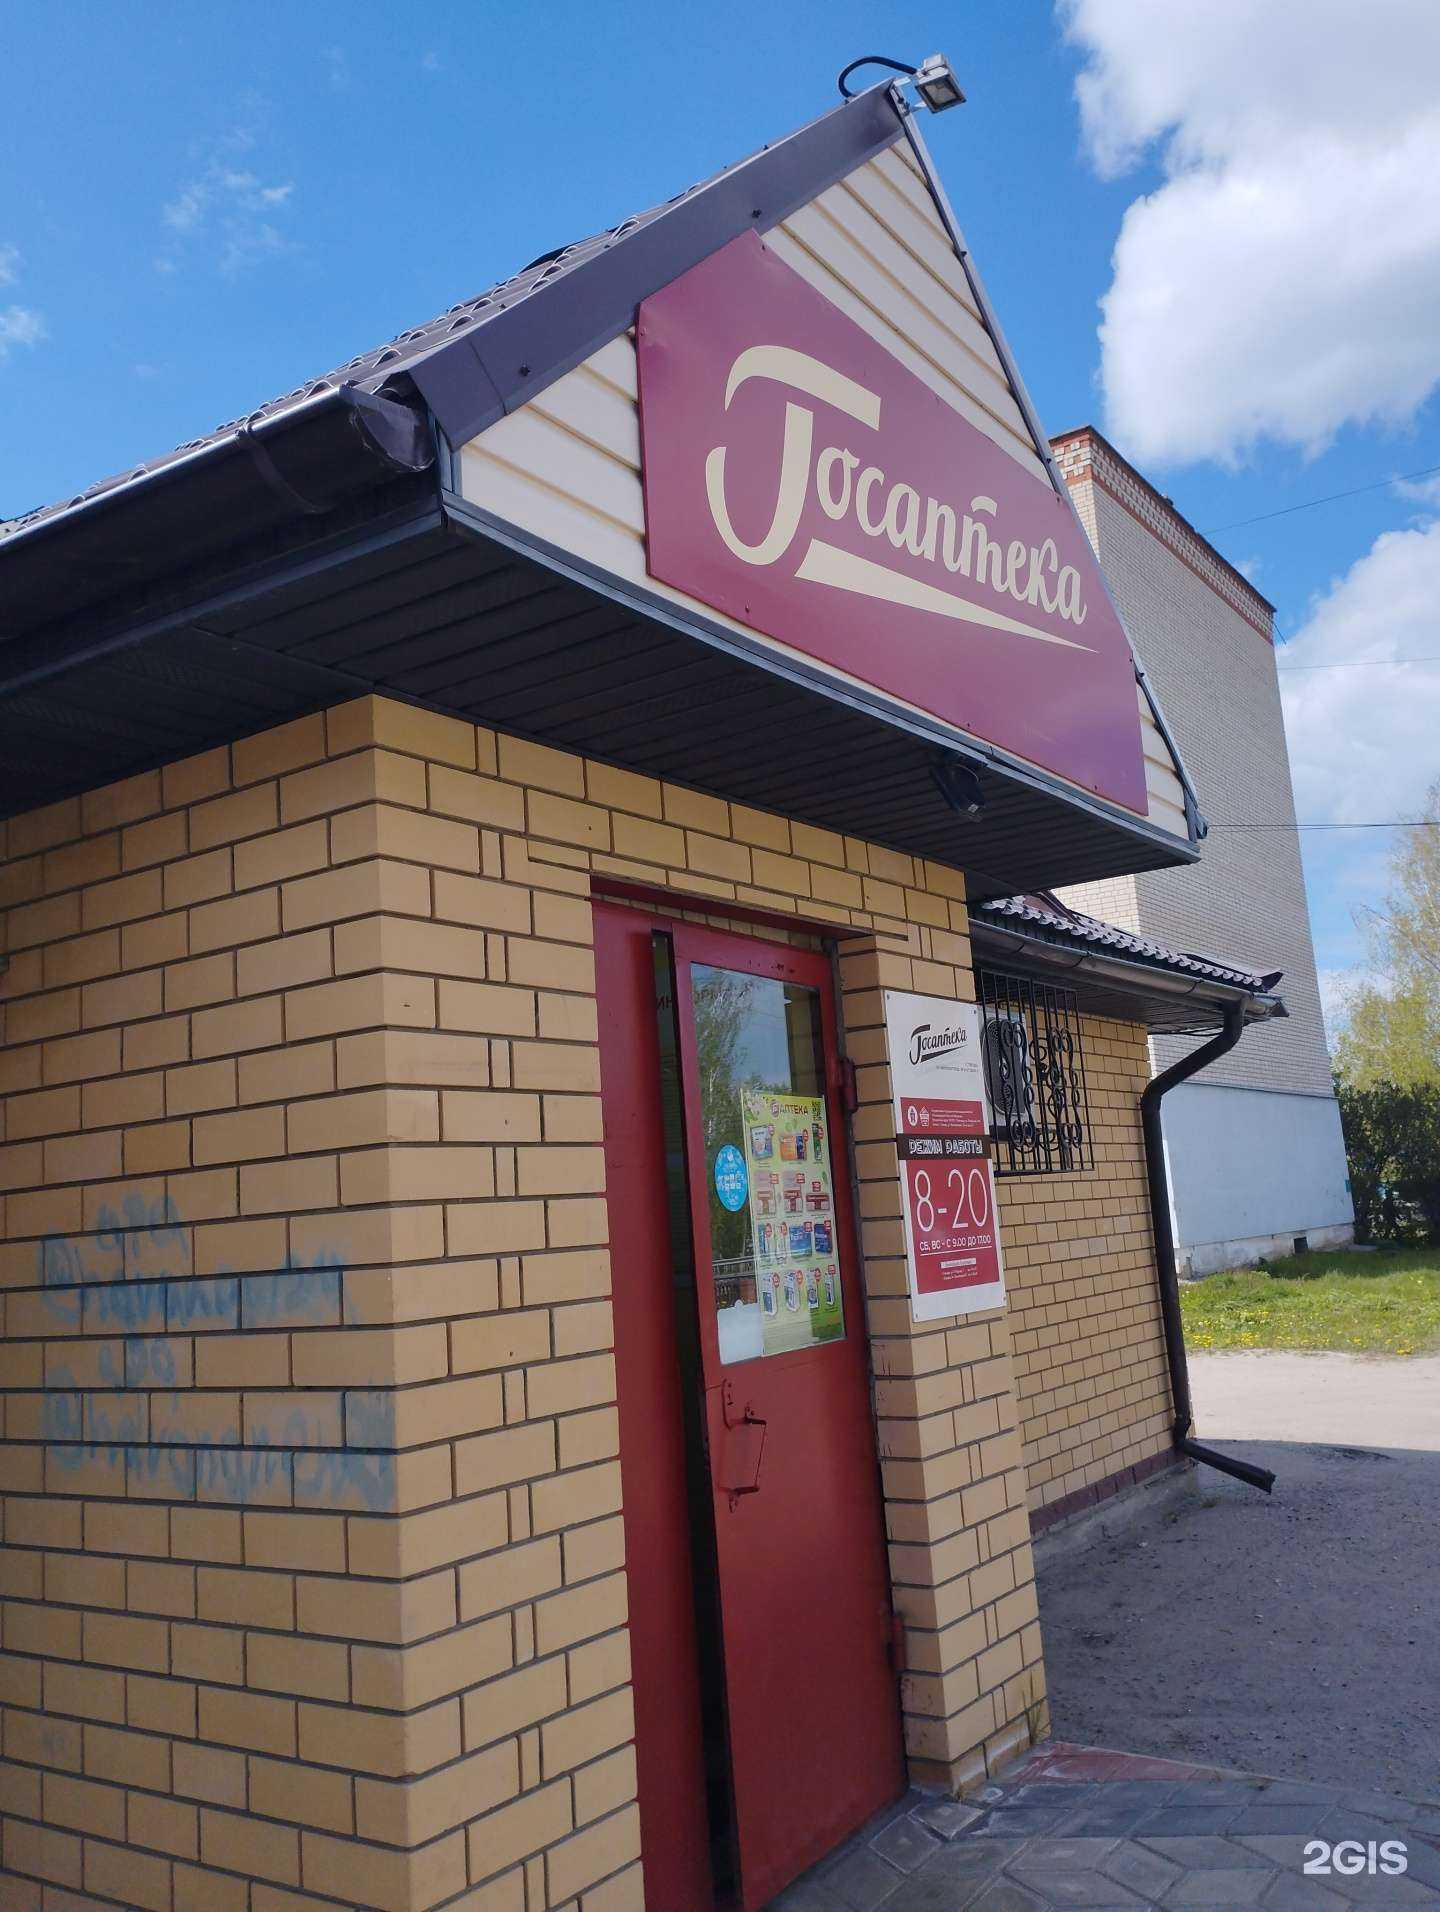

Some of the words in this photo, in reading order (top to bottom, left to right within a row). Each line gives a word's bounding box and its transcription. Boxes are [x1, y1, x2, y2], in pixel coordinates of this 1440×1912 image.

[705, 345, 1087, 625] Госаптека
[909, 1024, 967, 1065] Госаптека
[908, 1139, 942, 1154] РЕЖИМ
[945, 1139, 983, 1154] РАБОТЫ
[952, 1237, 966, 1248] 9.00
[967, 1237, 977, 1247] ДО
